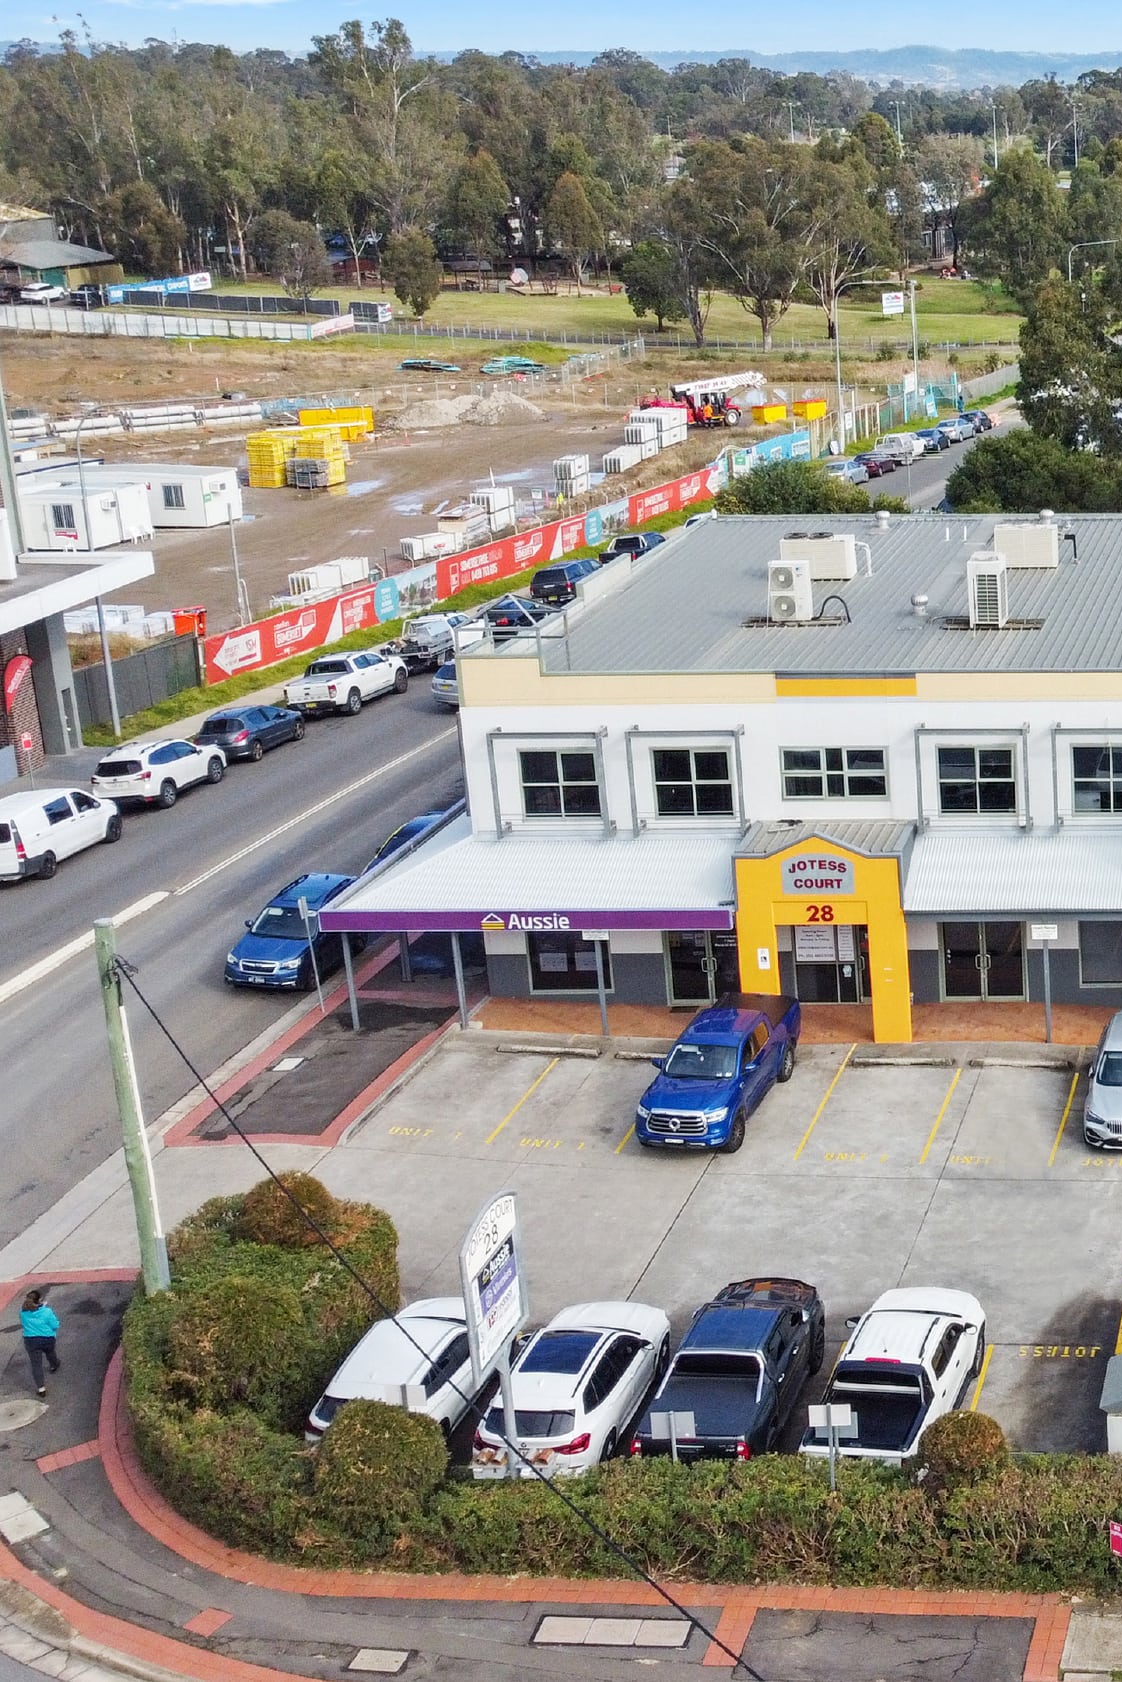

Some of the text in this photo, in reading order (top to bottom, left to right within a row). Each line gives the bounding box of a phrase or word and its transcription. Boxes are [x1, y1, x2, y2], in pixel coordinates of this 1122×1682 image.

[788, 860, 847, 874] JOTESS
[794, 879, 843, 889] COURT
[806, 905, 834, 922] 28
[508, 913, 570, 930] Aussie
[388, 1126, 433, 1137] UNIT
[520, 1137, 562, 1149] UNIT
[484, 1224, 499, 1255] 28
[1018, 1345, 1101, 1357] JOTESS
